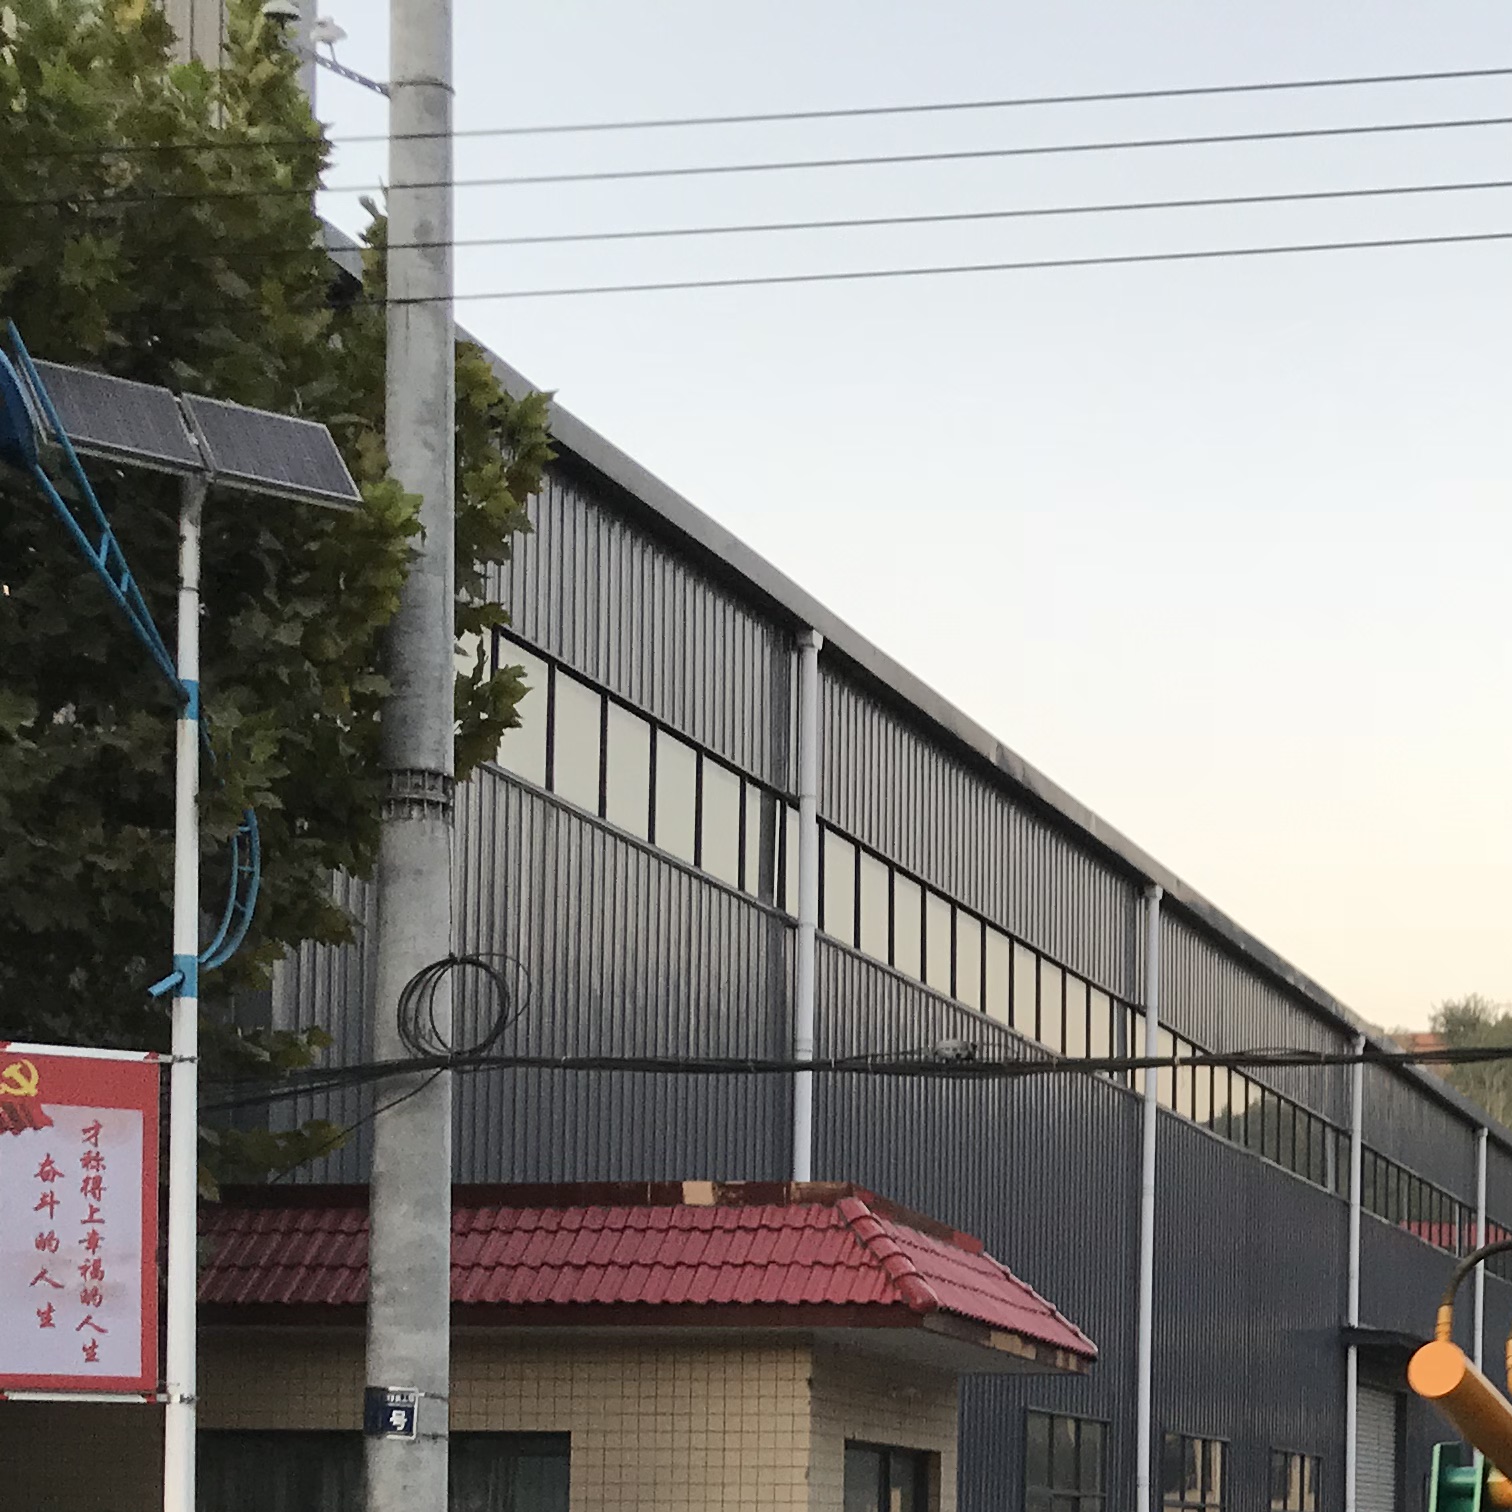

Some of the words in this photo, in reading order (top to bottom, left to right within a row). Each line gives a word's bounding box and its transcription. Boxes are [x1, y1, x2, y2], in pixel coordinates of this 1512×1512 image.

[30, 1153, 65, 1329] 奋斗的人生
